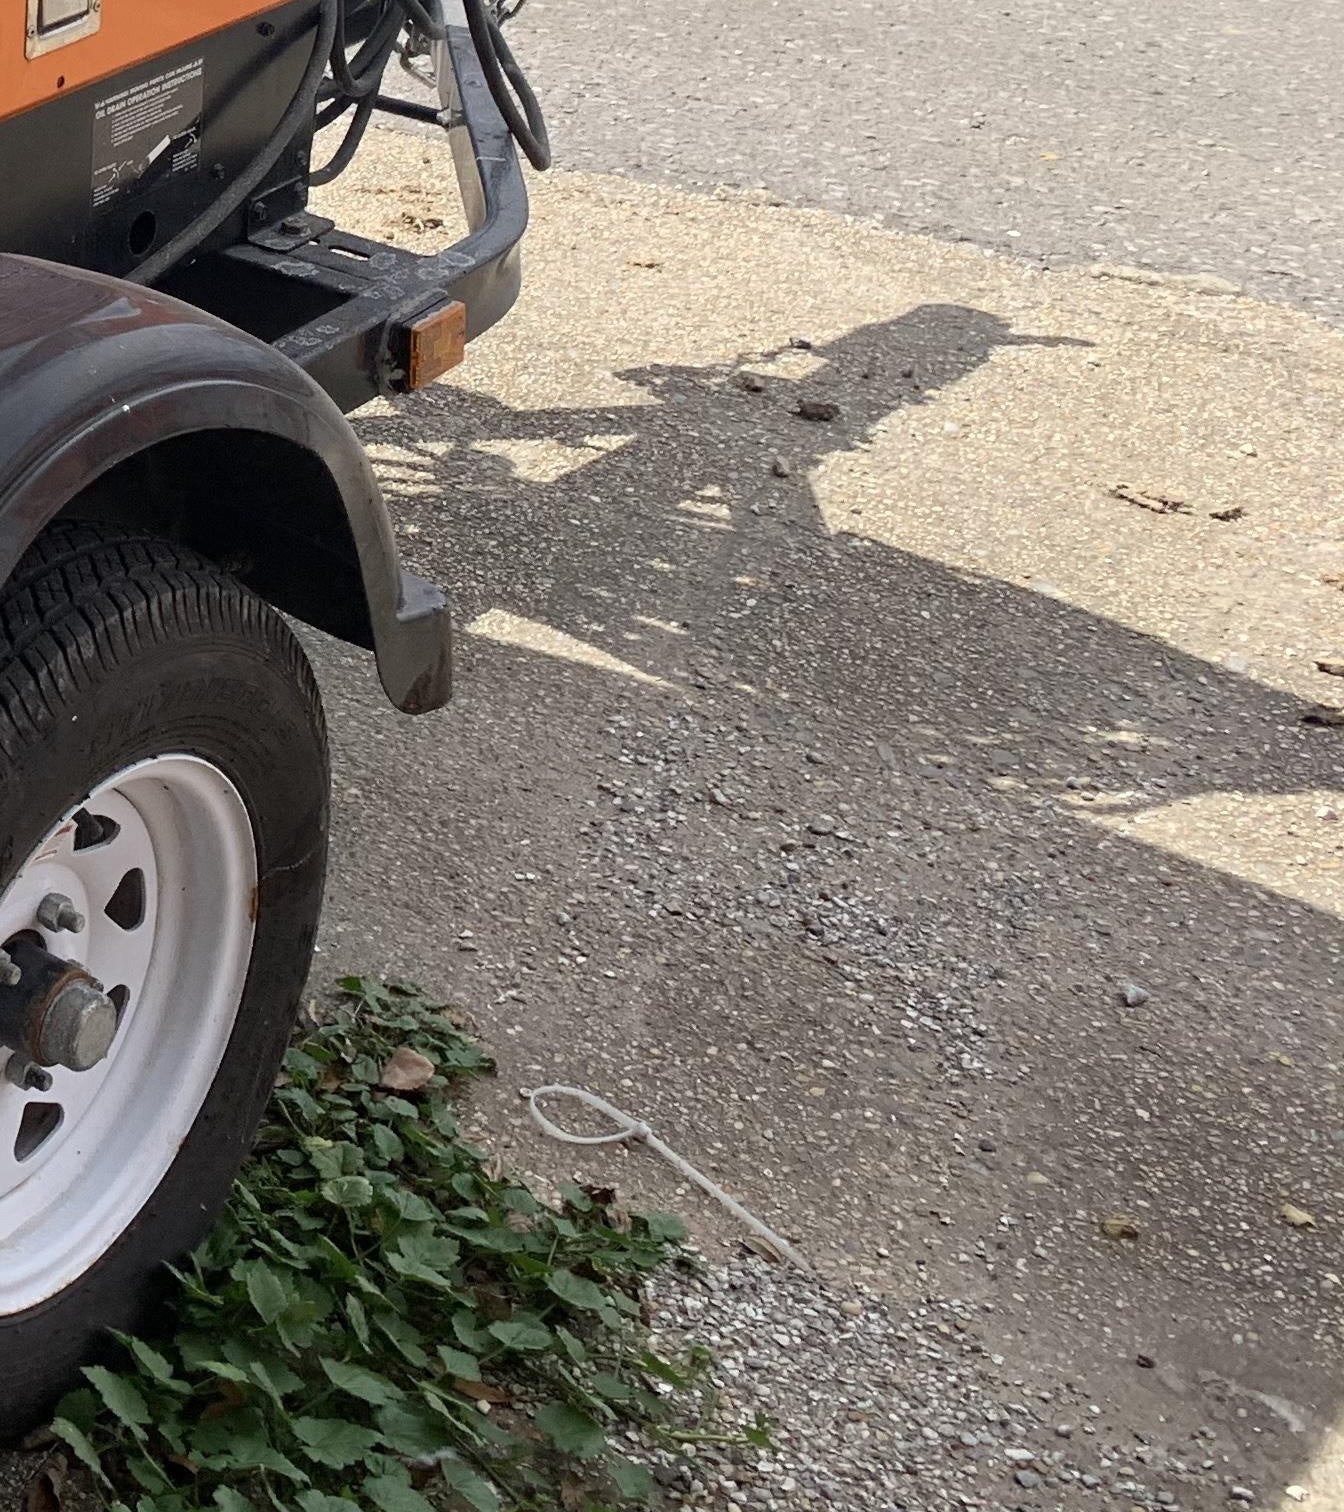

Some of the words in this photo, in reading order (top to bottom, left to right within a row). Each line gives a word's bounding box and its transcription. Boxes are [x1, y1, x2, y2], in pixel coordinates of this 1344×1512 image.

[106, 101, 126, 115] DRAIN
[127, 85, 161, 106] OPERATION
[161, 67, 202, 91] INSTRUCTIONS
